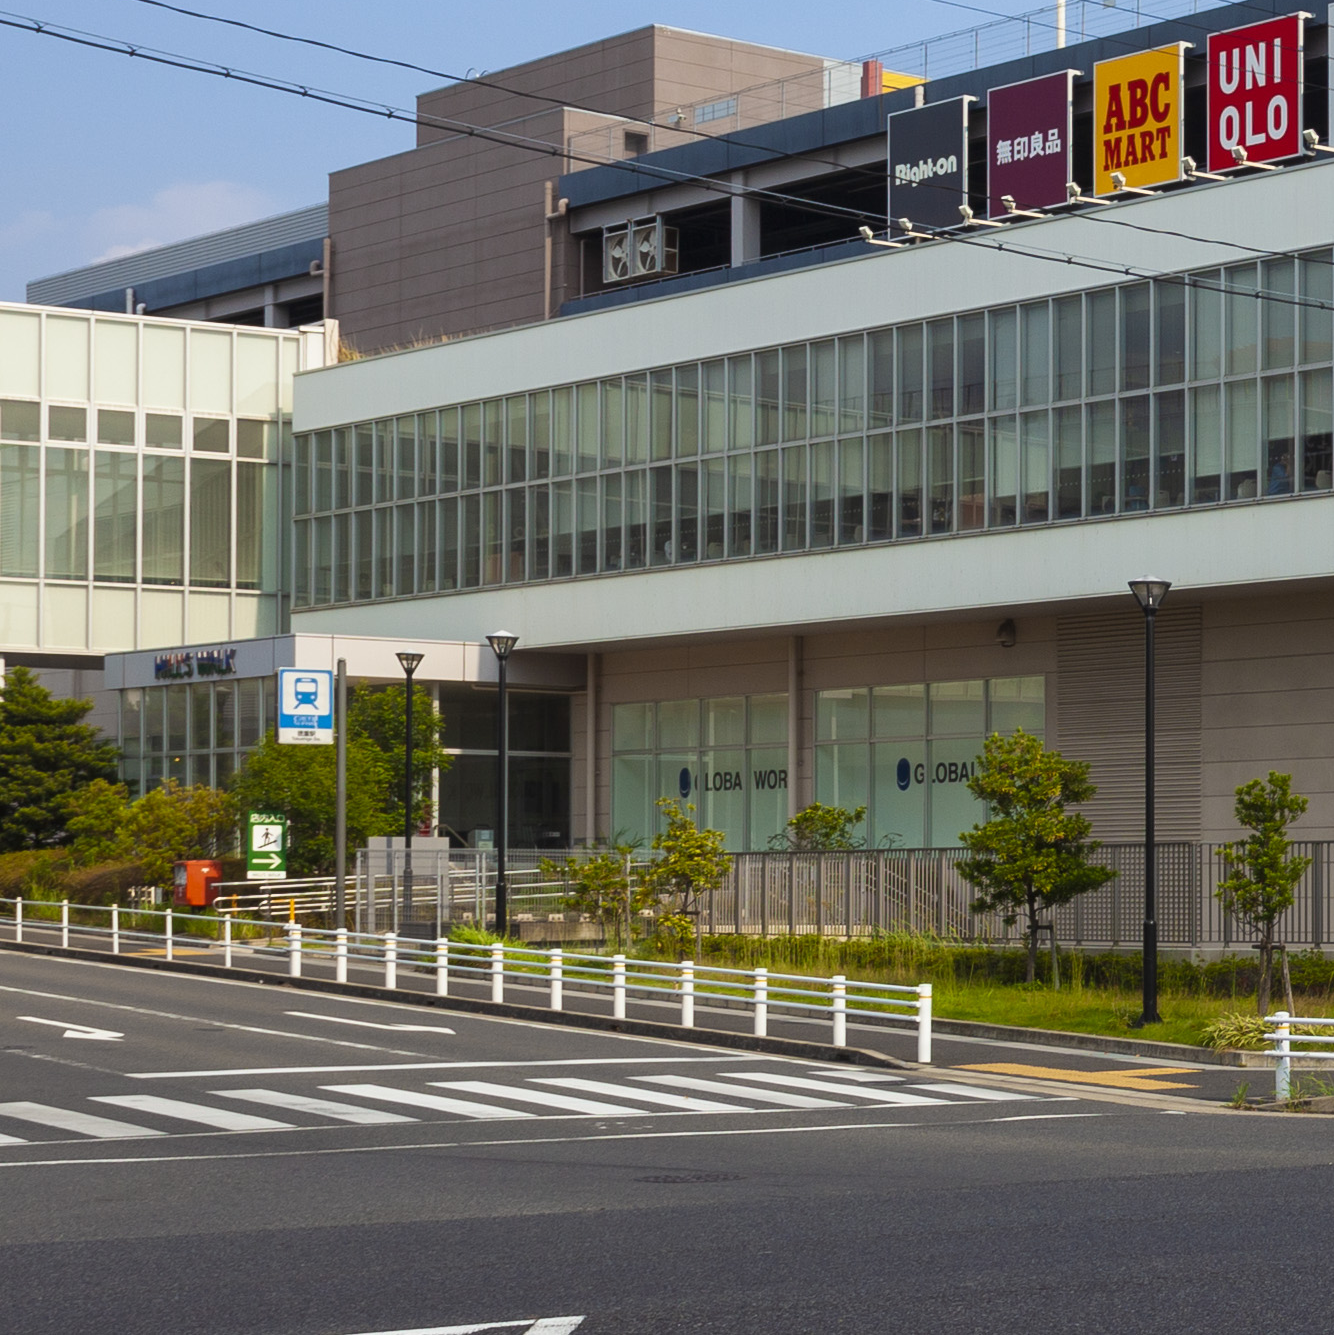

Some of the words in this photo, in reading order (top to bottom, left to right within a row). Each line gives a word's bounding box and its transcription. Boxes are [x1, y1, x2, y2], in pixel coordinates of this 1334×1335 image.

[1219, 37, 1283, 95] UNI
[1103, 71, 1171, 135] ABC
[1219, 95, 1289, 153] QLO
[895, 154, 958, 188] Right-on
[996, 128, 1062, 166] 無印良品
[1102, 126, 1172, 173] MART
